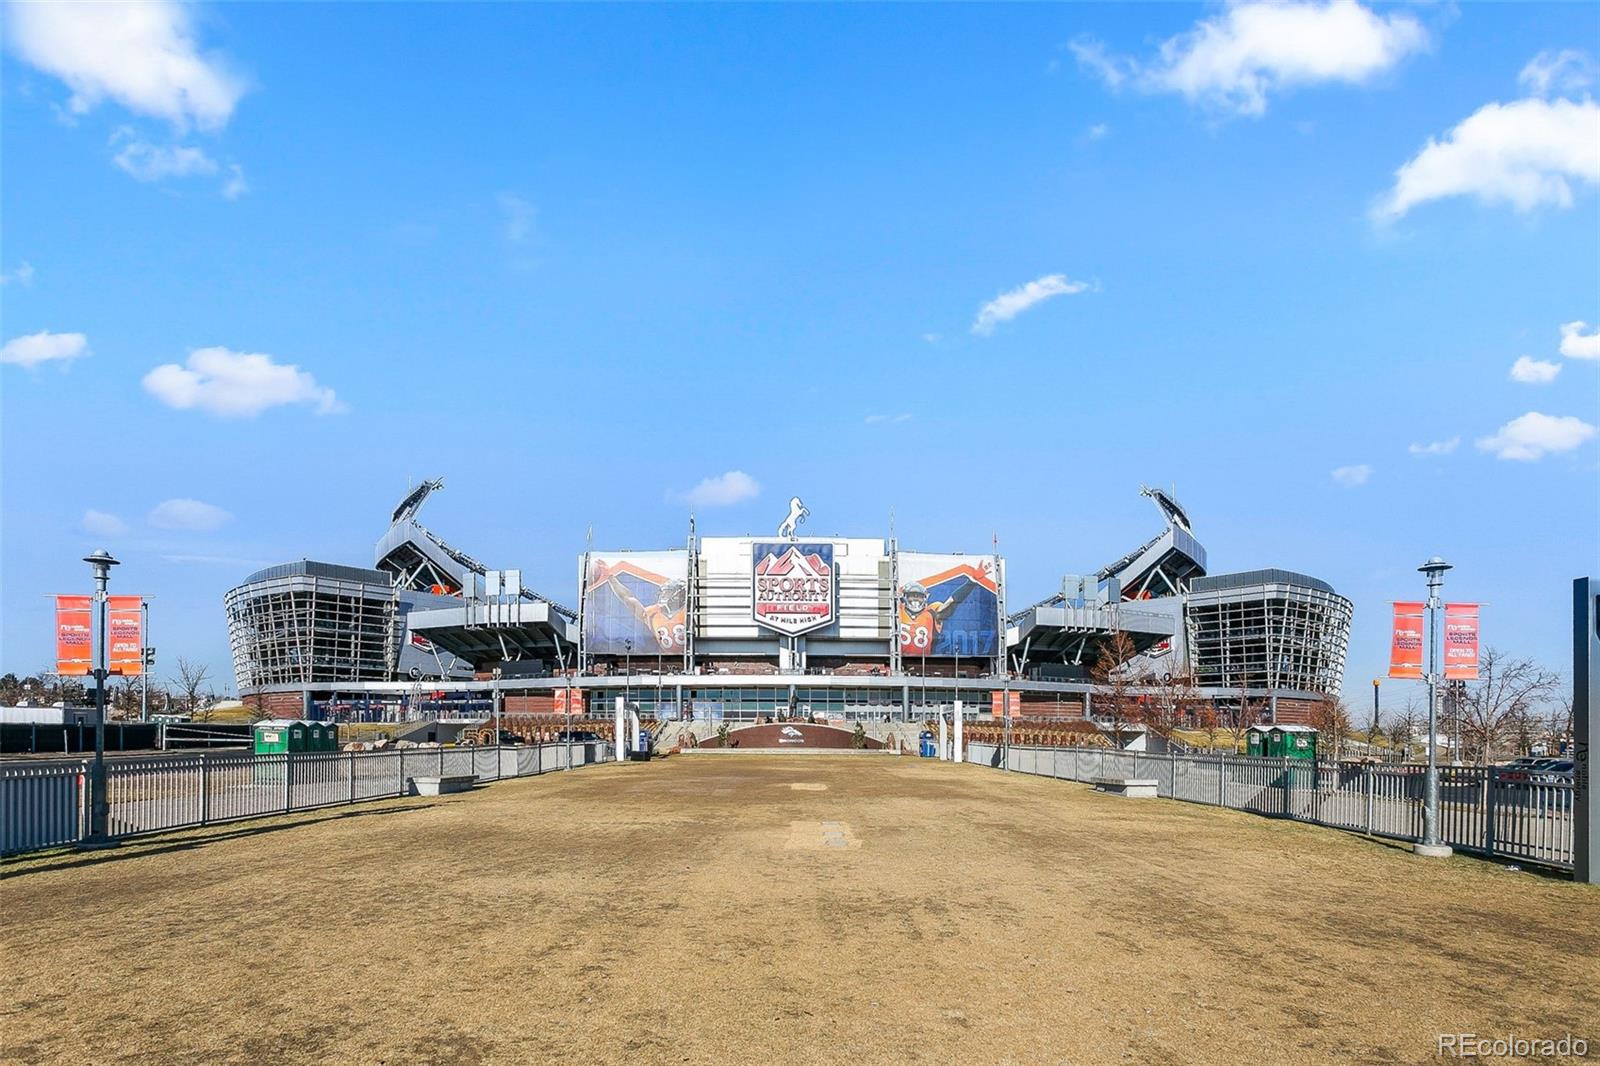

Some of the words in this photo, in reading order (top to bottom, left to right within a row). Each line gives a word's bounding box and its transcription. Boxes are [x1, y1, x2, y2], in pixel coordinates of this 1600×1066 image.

[757, 578, 829, 592] SPORTS
[758, 591, 828, 601] AUTHORITY
[800, 615, 817, 624] HIGH
[657, 624, 686, 649] 88
[900, 623, 929, 648] 58
[935, 630, 996, 656] 2017
